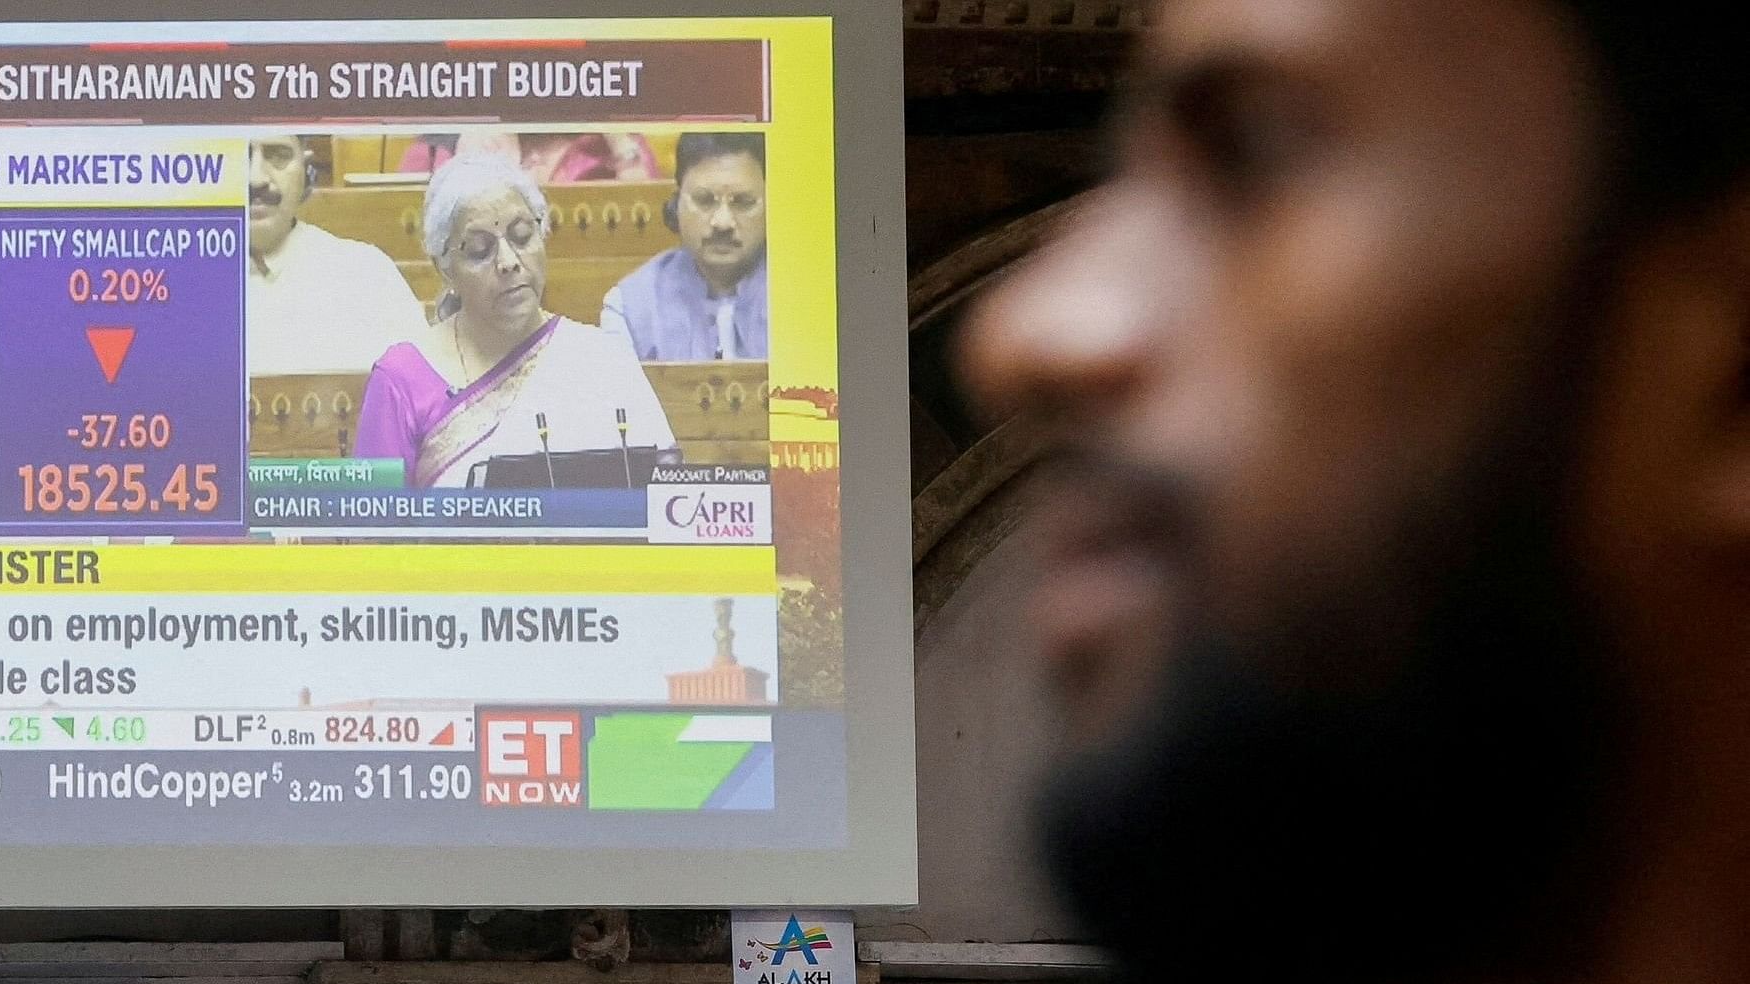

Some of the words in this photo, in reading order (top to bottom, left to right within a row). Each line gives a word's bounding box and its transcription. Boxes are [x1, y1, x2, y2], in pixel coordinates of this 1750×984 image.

[265, 64, 319, 99] 7th
[330, 62, 497, 98] STRAIGHT
[508, 60, 643, 97] BUDGET
[8, 155, 142, 185] MARKETS
[150, 154, 224, 184] NOW
[1, 230, 66, 258] NIFTY
[71, 229, 190, 257] SMALLCAP
[195, 228, 236, 257] 100
[69, 269, 169, 303] 0.20%
[67, 414, 171, 449] -37.60
[19, 464, 219, 512] 18525.45
[254, 497, 320, 517] CHAIR
[340, 496, 434, 517] HON'BLE
[442, 496, 542, 517] SPEAKER
[665, 492, 754, 528] CAPRI
[696, 524, 754, 537] LOANS
[7, 614, 52, 643] on
[65, 607, 308, 649] employment,
[320, 605, 468, 649] skilling,
[481, 608, 619, 643] MSMEs
[39, 661, 137, 695] class
[86, 716, 146, 742] 4.60
[194, 715, 253, 743] DLF
[271, 730, 316, 746] 0.8m
[325, 716, 420, 743] 824.80
[487, 720, 573, 775] ET
[49, 763, 268, 807] HindCopper
[289, 780, 343, 803] 3.2m
[355, 763, 472, 800] 311.90
[486, 782, 581, 803] NOW
